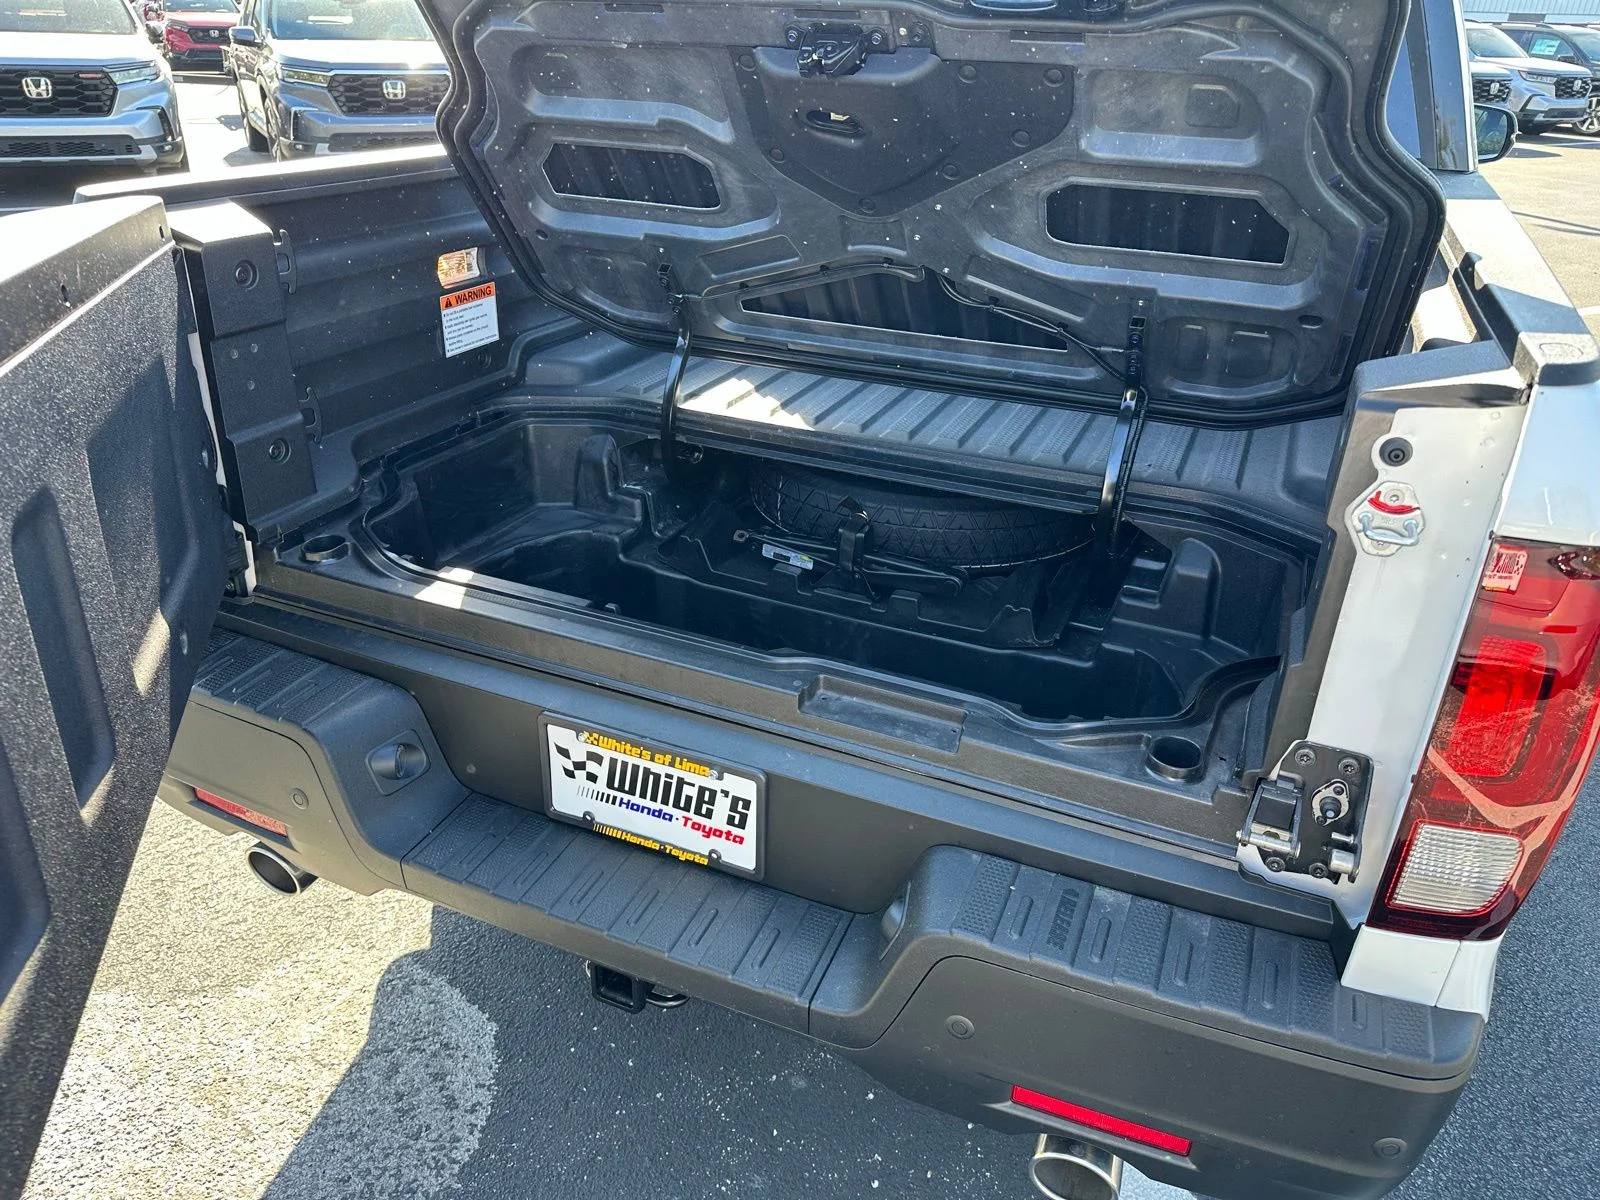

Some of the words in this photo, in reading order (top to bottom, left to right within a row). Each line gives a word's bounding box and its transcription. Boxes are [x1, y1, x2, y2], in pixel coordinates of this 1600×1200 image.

[455, 286, 491, 304] WARNING
[597, 735, 651, 760] White's
[655, 753, 672, 765] of
[675, 758, 710, 777] Lima
[606, 757, 752, 830] White's
[619, 798, 673, 822] Honda
[682, 816, 744, 845] Toyota
[622, 833, 660, 850] Honda
[665, 845, 709, 866] Toyota
